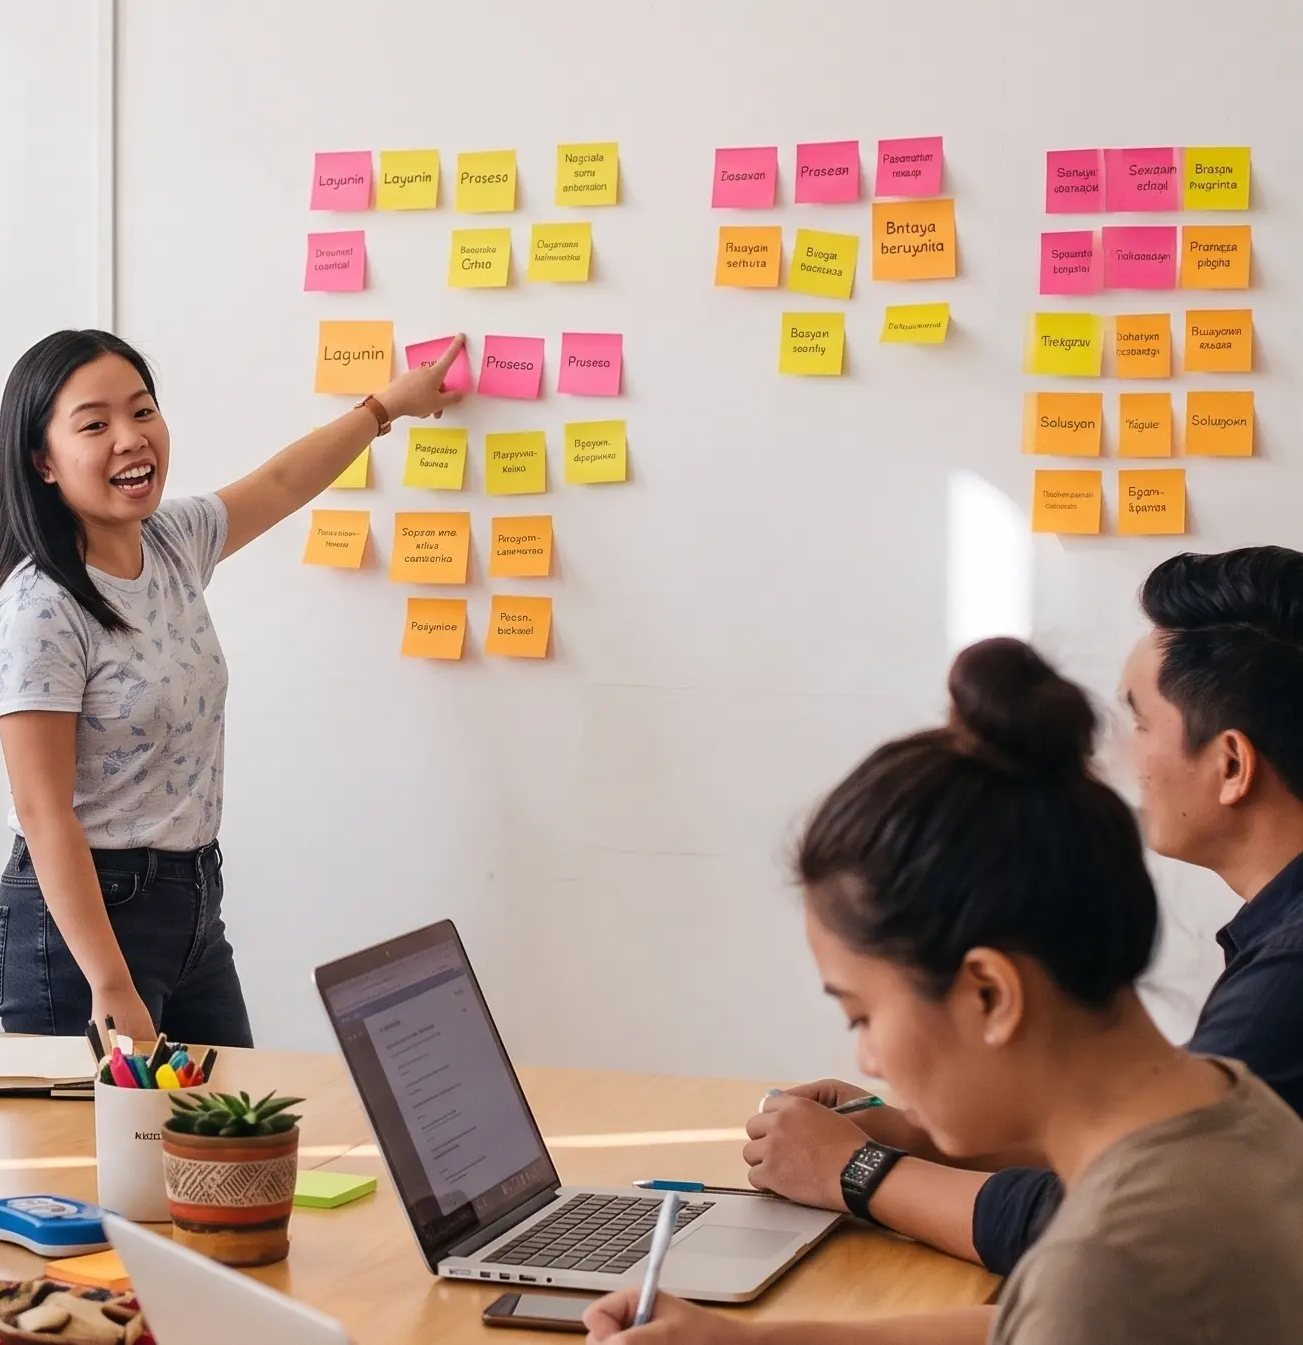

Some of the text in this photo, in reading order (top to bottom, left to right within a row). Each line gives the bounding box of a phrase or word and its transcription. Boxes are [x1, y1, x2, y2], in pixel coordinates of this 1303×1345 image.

[319, 174, 364, 190] Layunin
[384, 172, 432, 188] Layunin
[324, 345, 384, 366] Lagunin
[486, 355, 534, 371] Proseso
